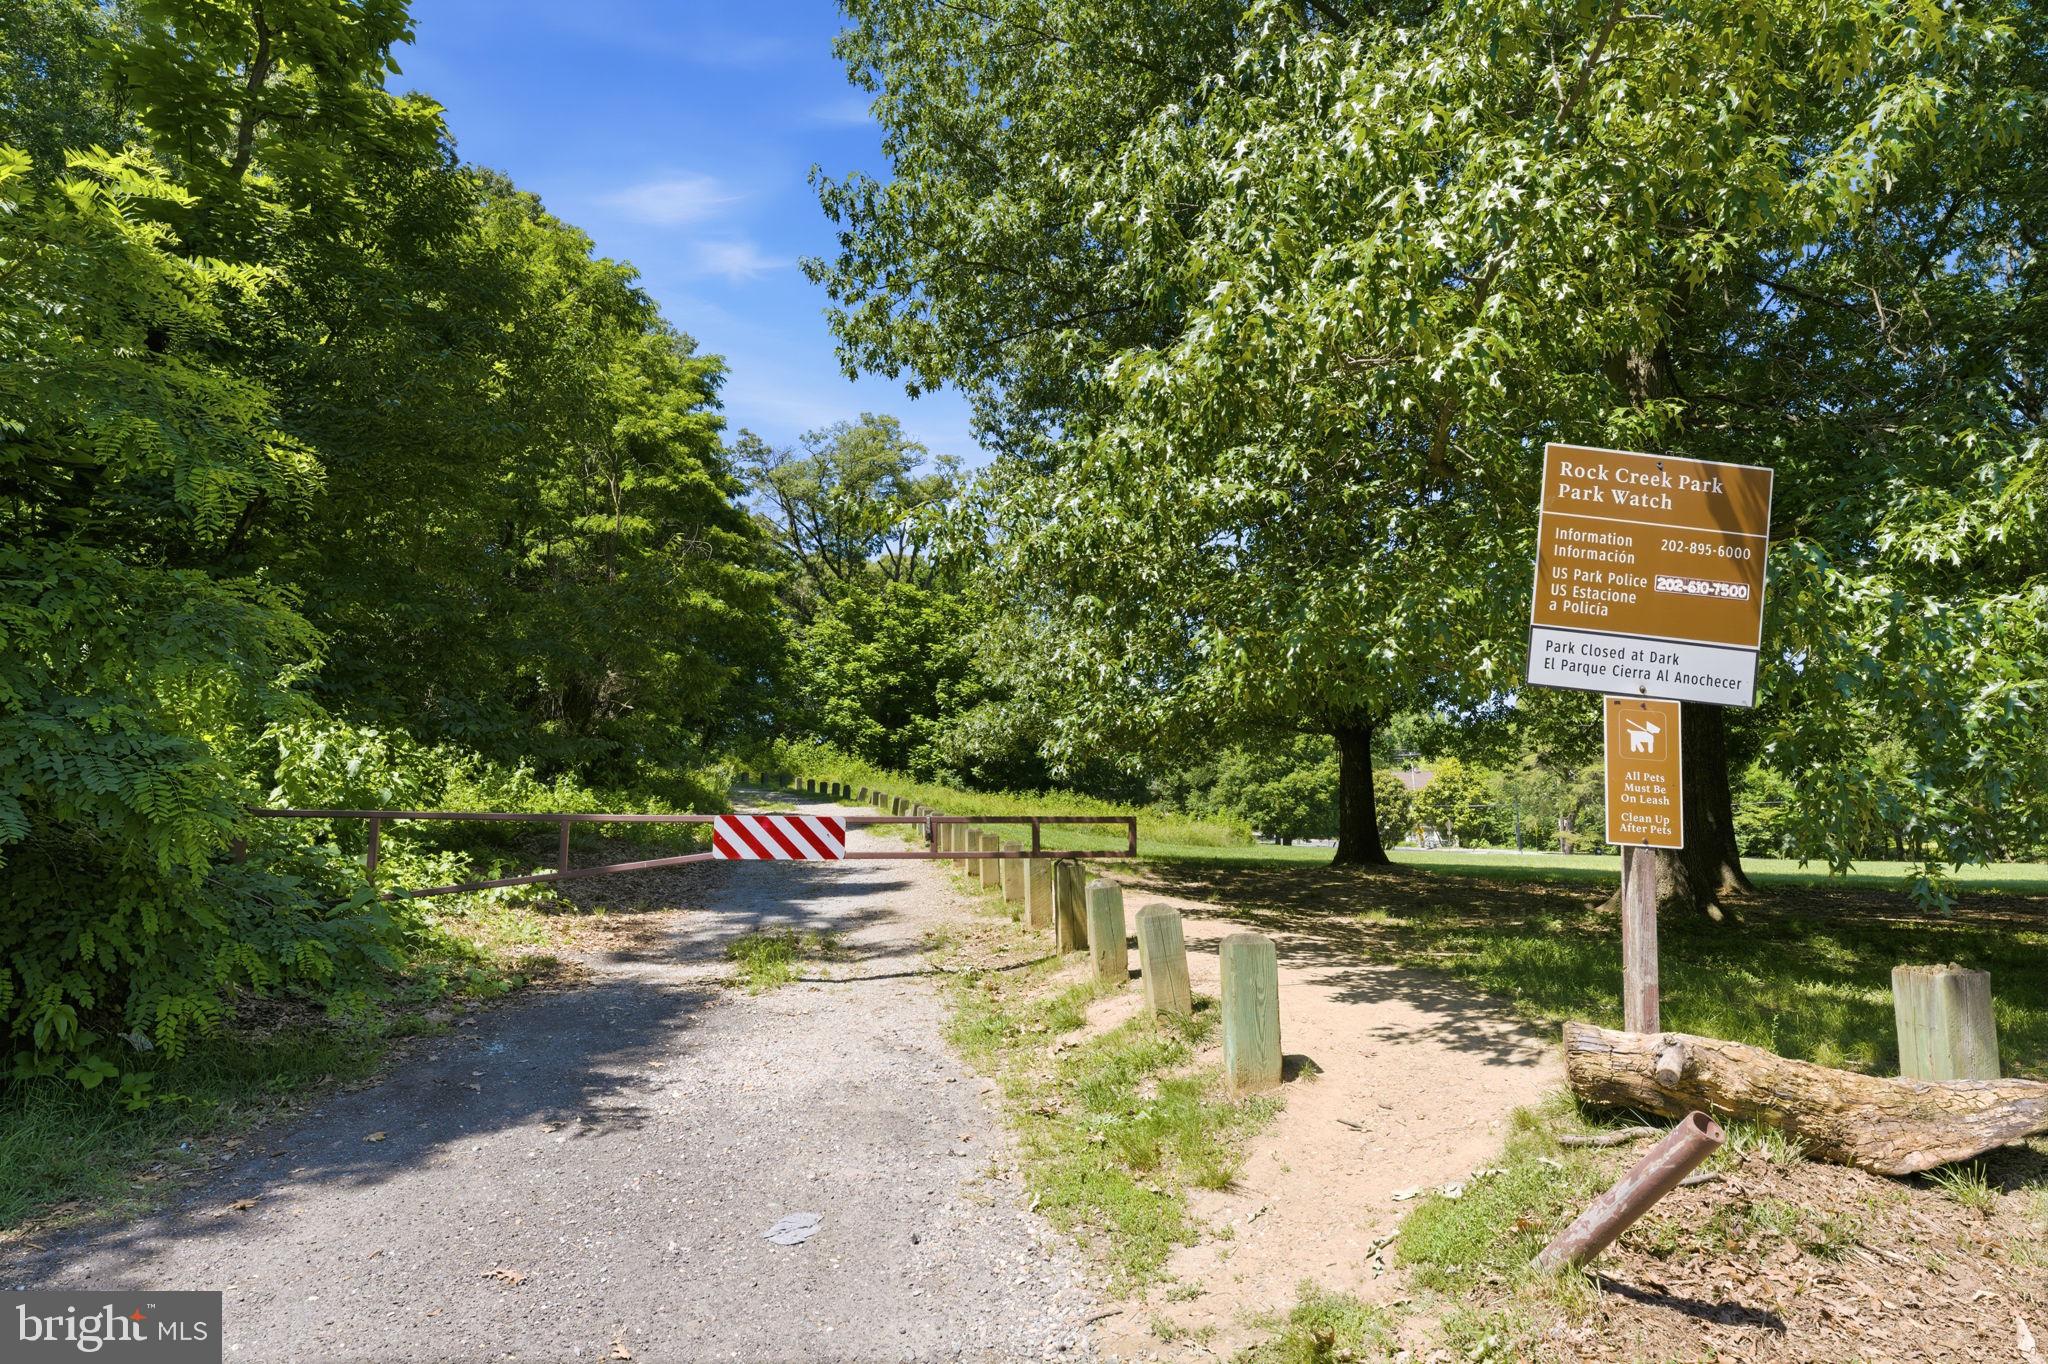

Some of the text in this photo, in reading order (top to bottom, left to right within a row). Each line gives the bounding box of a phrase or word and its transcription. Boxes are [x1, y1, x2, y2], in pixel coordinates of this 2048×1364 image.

[1560, 461, 1723, 494] Rock Creek Park
[1558, 483, 1672, 510] Park Watch
[1555, 527, 1632, 547] Information
[1554, 545, 1635, 564] Información
[1661, 539, 1751, 560] 202-895-6000
[1552, 566, 1648, 588] US Park Police
[1551, 584, 1637, 604] US Estacione
[1656, 577, 1747, 598] 202-610-7500
[1549, 600, 1608, 616] a Policía
[1545, 640, 1679, 666] Park Closed at Dark
[1544, 657, 1742, 690] El Parque Cierra Al Anochecer
[1625, 771, 1665, 783] All Pets
[1624, 783, 1666, 794] Must Be
[1621, 794, 1670, 805] On Leash
[1619, 823, 1672, 835] After Pets
[1621, 812, 1670, 827] Clean Up
